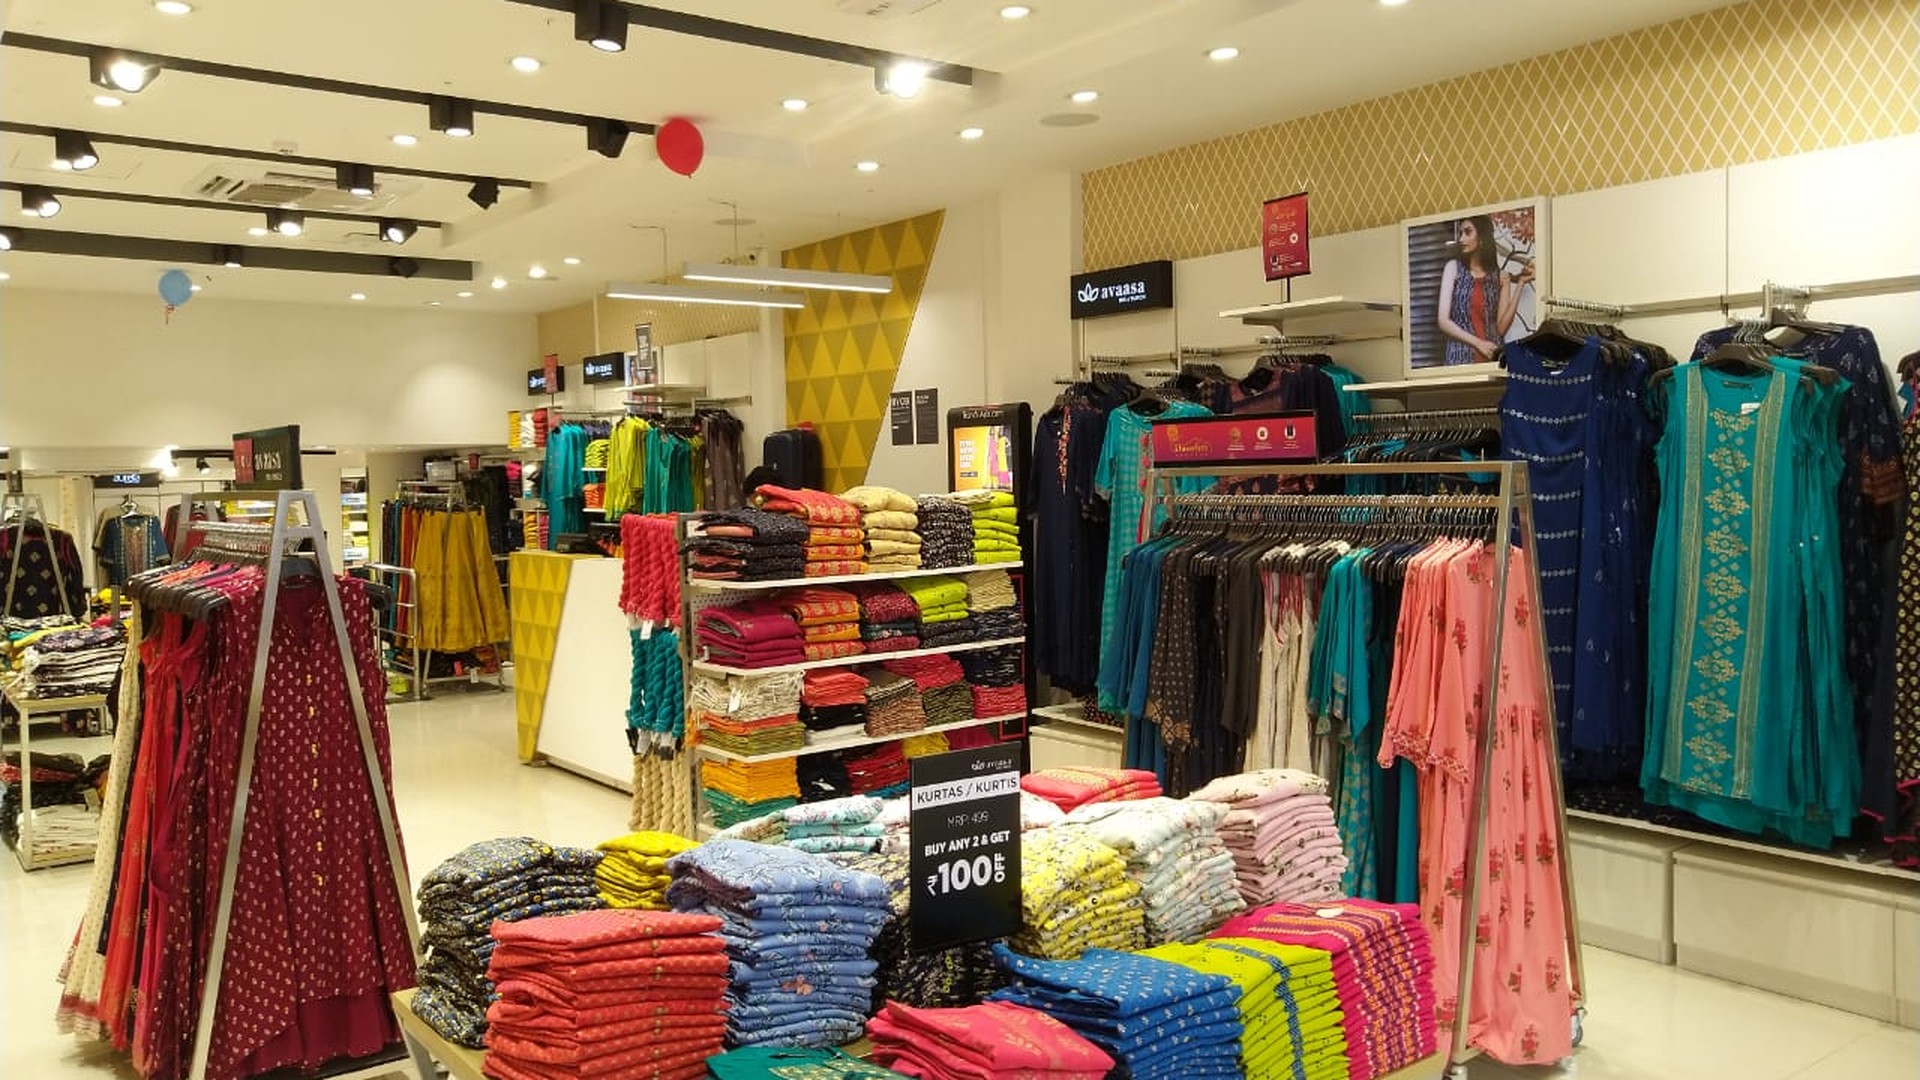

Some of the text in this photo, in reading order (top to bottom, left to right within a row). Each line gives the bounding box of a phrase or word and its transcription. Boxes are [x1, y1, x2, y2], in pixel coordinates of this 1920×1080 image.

[1101, 281, 1145, 299] avaasa
[917, 785, 964, 803] KURTAS
[975, 777, 1017, 794] KURTIS
[924, 830, 1011, 857] BUY ANY 2 & GET
[994, 852, 1006, 883] OFF
